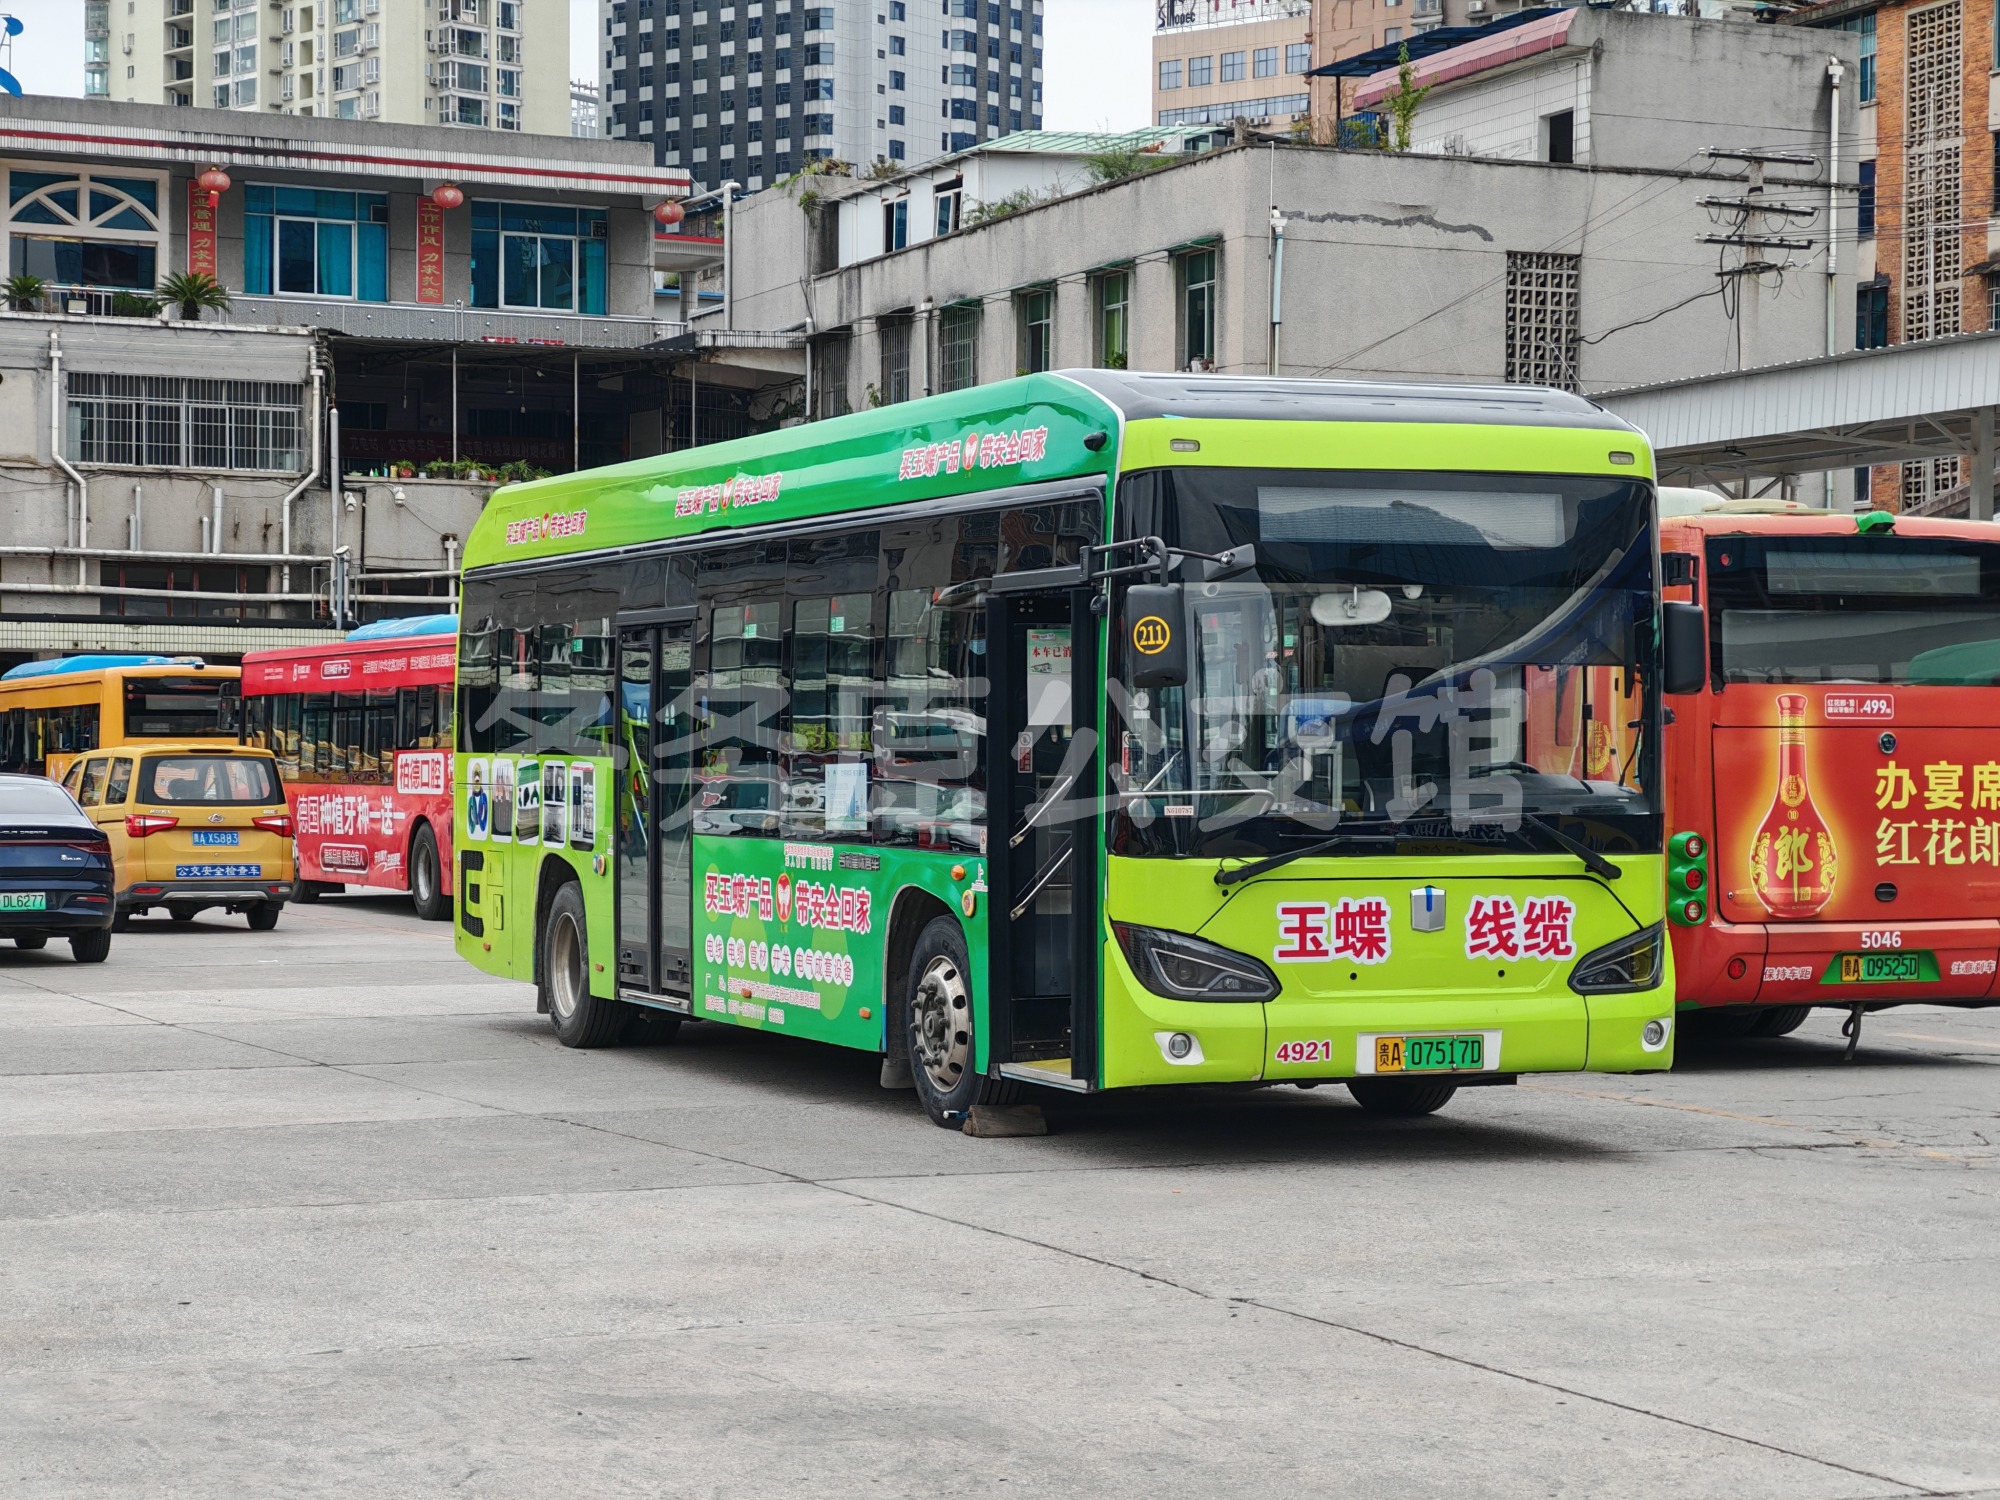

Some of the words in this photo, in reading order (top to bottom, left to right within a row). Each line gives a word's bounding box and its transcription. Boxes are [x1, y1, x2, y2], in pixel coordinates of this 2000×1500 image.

[899, 440, 961, 482] 买玉蝶产品
[980, 424, 1048, 470] 带安全回家
[674, 483, 721, 519] 买玉蝶产品
[732, 471, 783, 508] 带安全回家
[1139, 625, 1164, 646] 211
[399, 758, 442, 790] 柏德口腔
[1875, 760, 2000, 811] 办宴席
[1875, 816, 2000, 867] 红花郎
[177, 865, 260, 877] 公交安全检查车
[1774, 825, 1814, 903] 郎
[2, 896, 45, 909] DL6277
[704, 872, 773, 921] 买玉蝶产品
[795, 880, 872, 935] 带安全回家
[1273, 896, 1392, 966] 玉蝶
[1465, 894, 1577, 963] 线缆
[1861, 931, 1902, 948] 5046
[705, 933, 724, 965] 电线
[794, 946, 853, 987] 电气成套设备
[1763, 967, 1813, 982] 保持车距
[1950, 960, 1996, 975] 注意刹车
[1275, 1040, 1333, 1064] 4921
